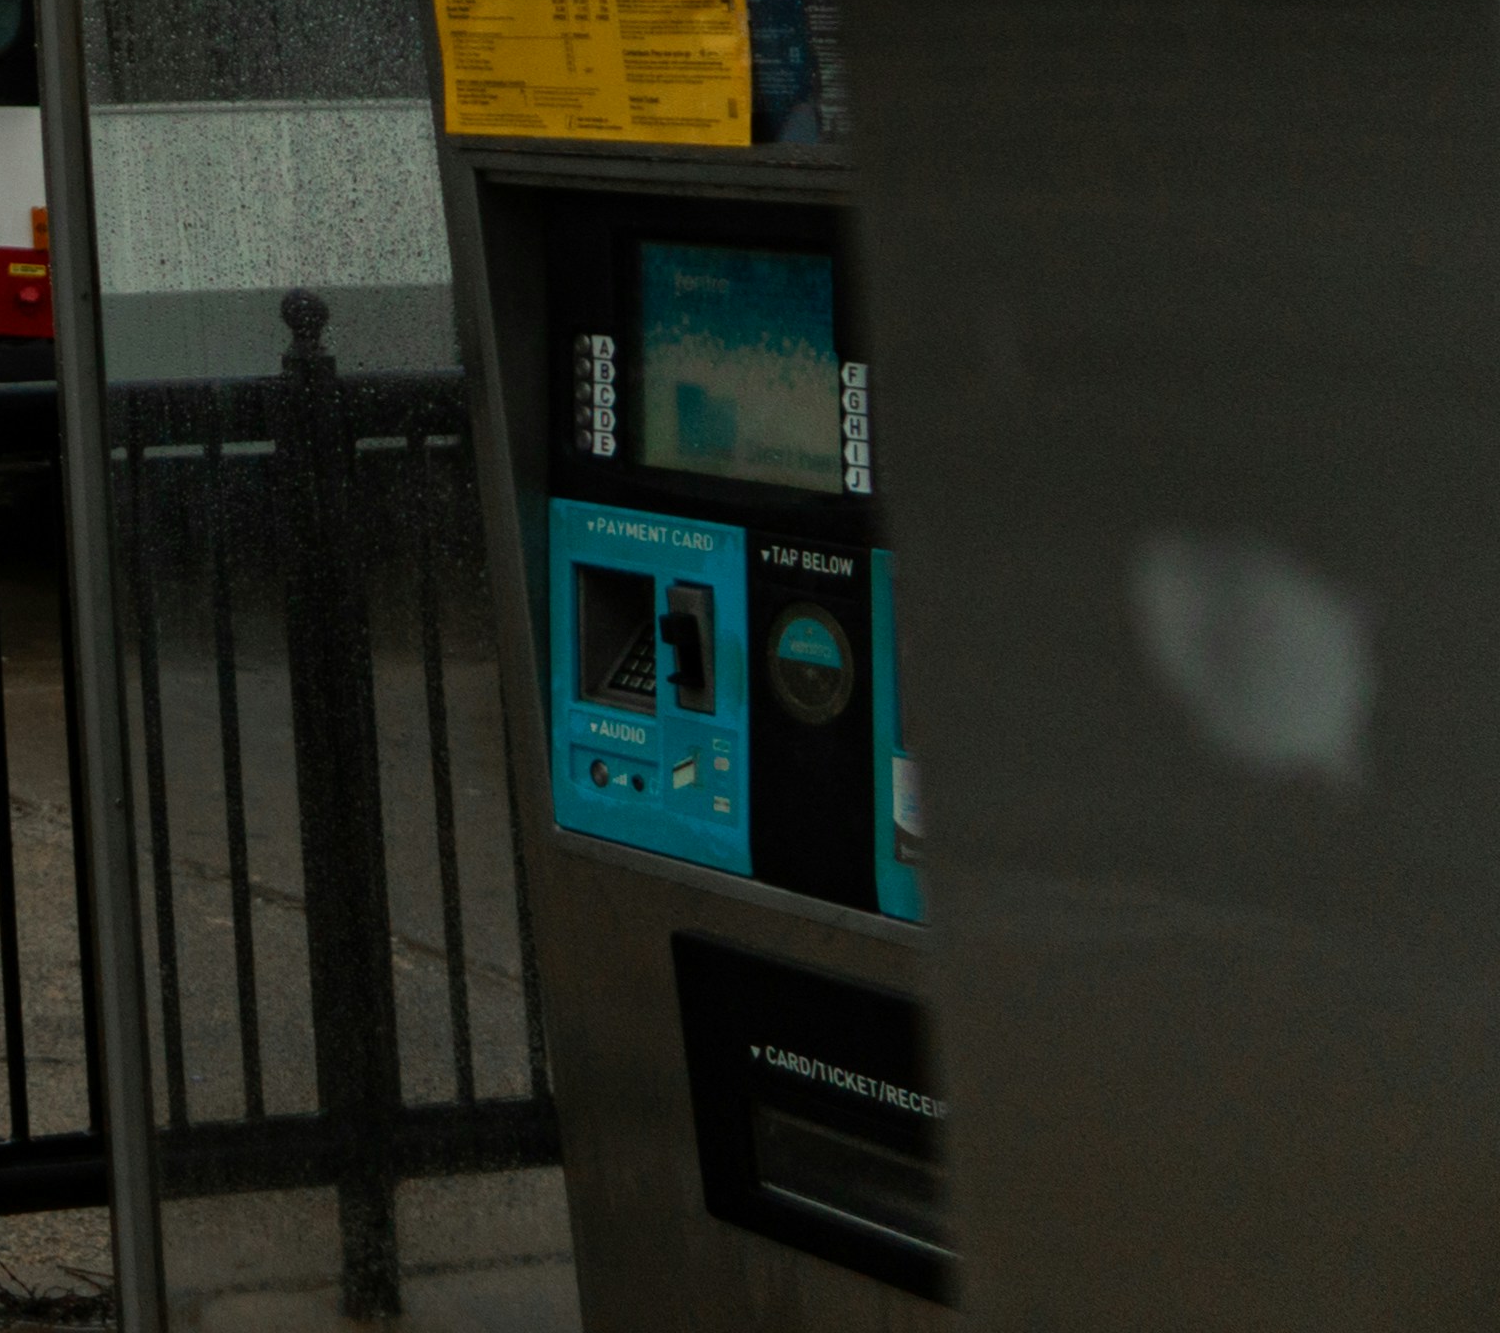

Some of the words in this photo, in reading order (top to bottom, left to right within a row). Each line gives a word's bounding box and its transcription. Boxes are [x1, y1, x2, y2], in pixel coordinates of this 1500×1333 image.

[600, 339, 609, 356] A
[601, 363, 609, 379] B
[848, 366, 858, 383] F
[600, 387, 609, 404] C
[848, 392, 859, 410] G
[601, 411, 610, 428] D
[850, 417, 860, 436] H
[601, 436, 610, 452] E
[851, 471, 860, 488] J
[597, 517, 667, 544] PAYMENT
[671, 529, 714, 552] CARD
[772, 545, 799, 566] TAP
[802, 550, 854, 577] BELOW
[599, 719, 646, 745] AUDIO
